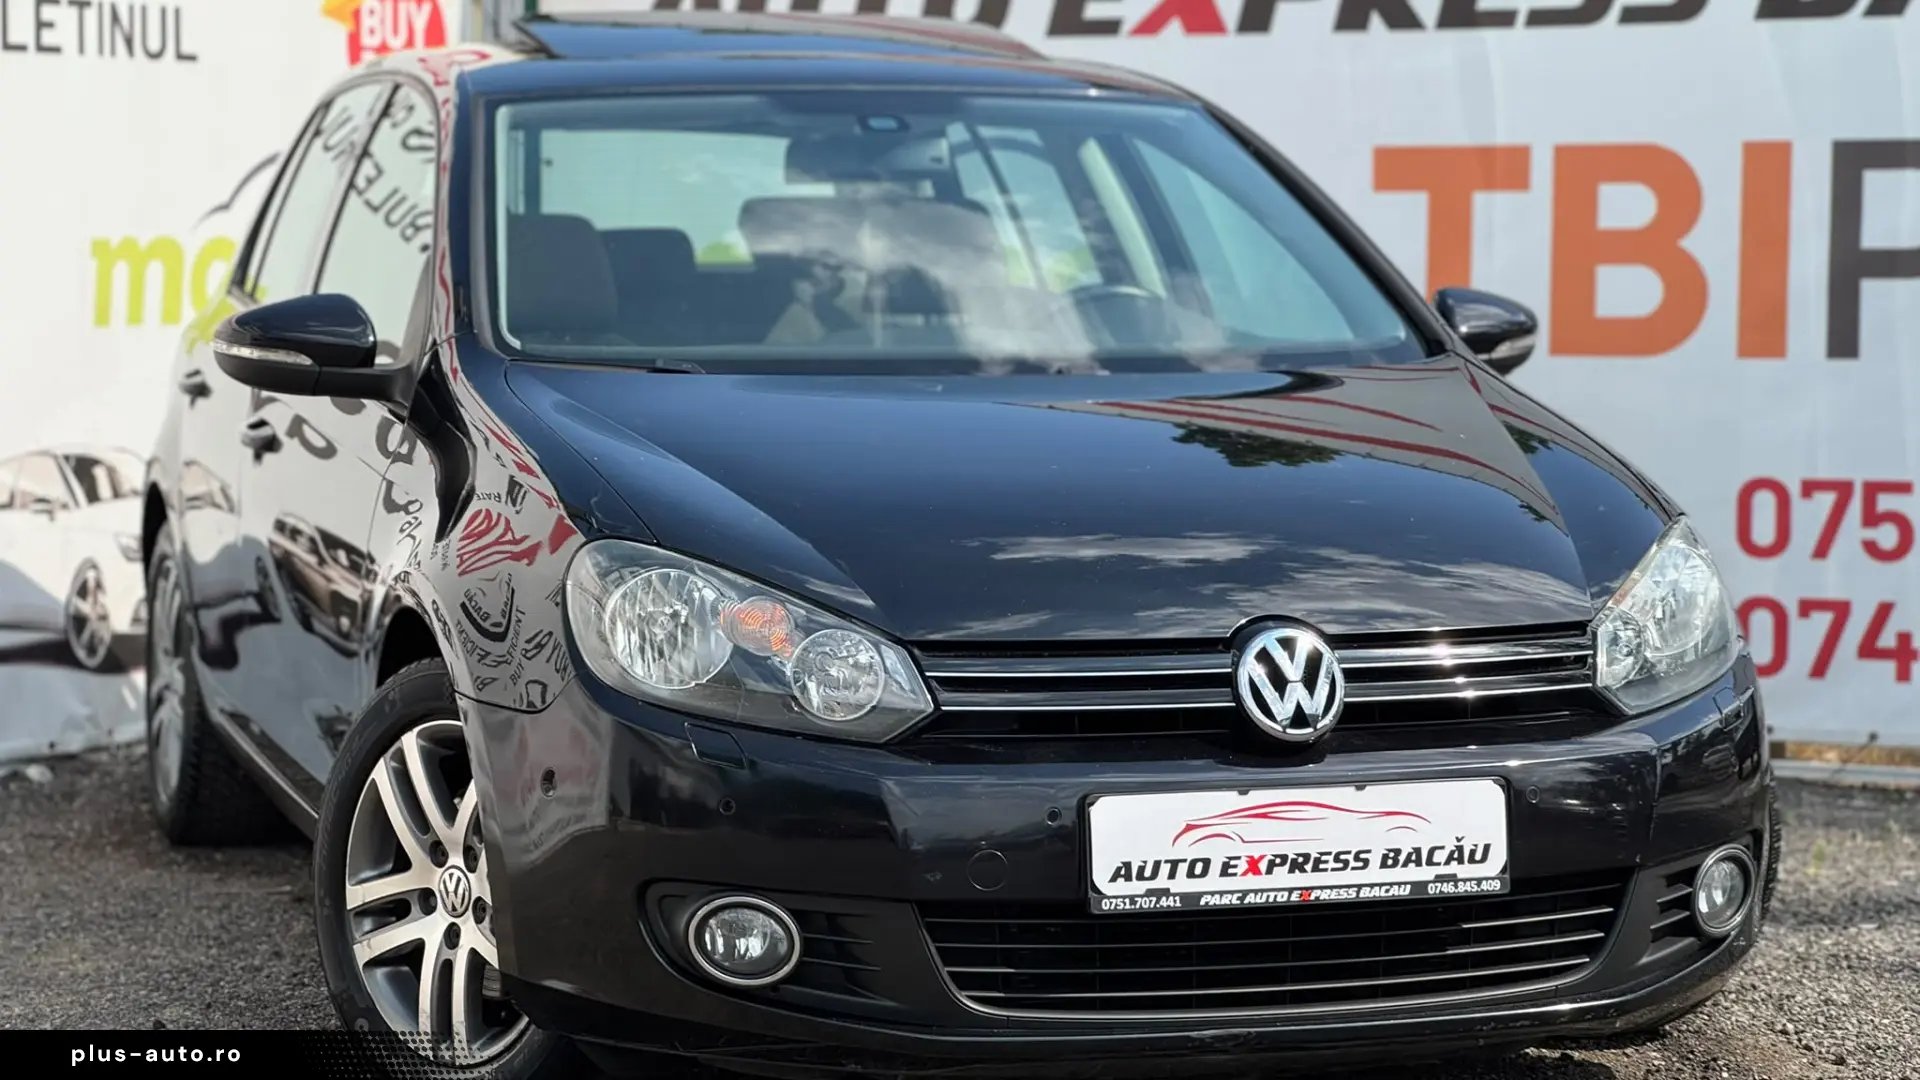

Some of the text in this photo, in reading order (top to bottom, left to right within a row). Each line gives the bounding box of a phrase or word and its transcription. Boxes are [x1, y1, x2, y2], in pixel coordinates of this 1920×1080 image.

[1, 0, 199, 61] LETINUL
[360, 0, 434, 51] BUY
[1736, 476, 1915, 563] 075
[1736, 595, 1920, 684] 074
[1239, 629, 1344, 740] VW
[1107, 836, 1492, 884] AUTO EXPRESS BACĂU
[1101, 896, 1182, 911] 0751.707.441
[1200, 884, 1411, 906] PARC AUTO EXPRESS BACAU
[1427, 879, 1501, 895] 0746.845.409
